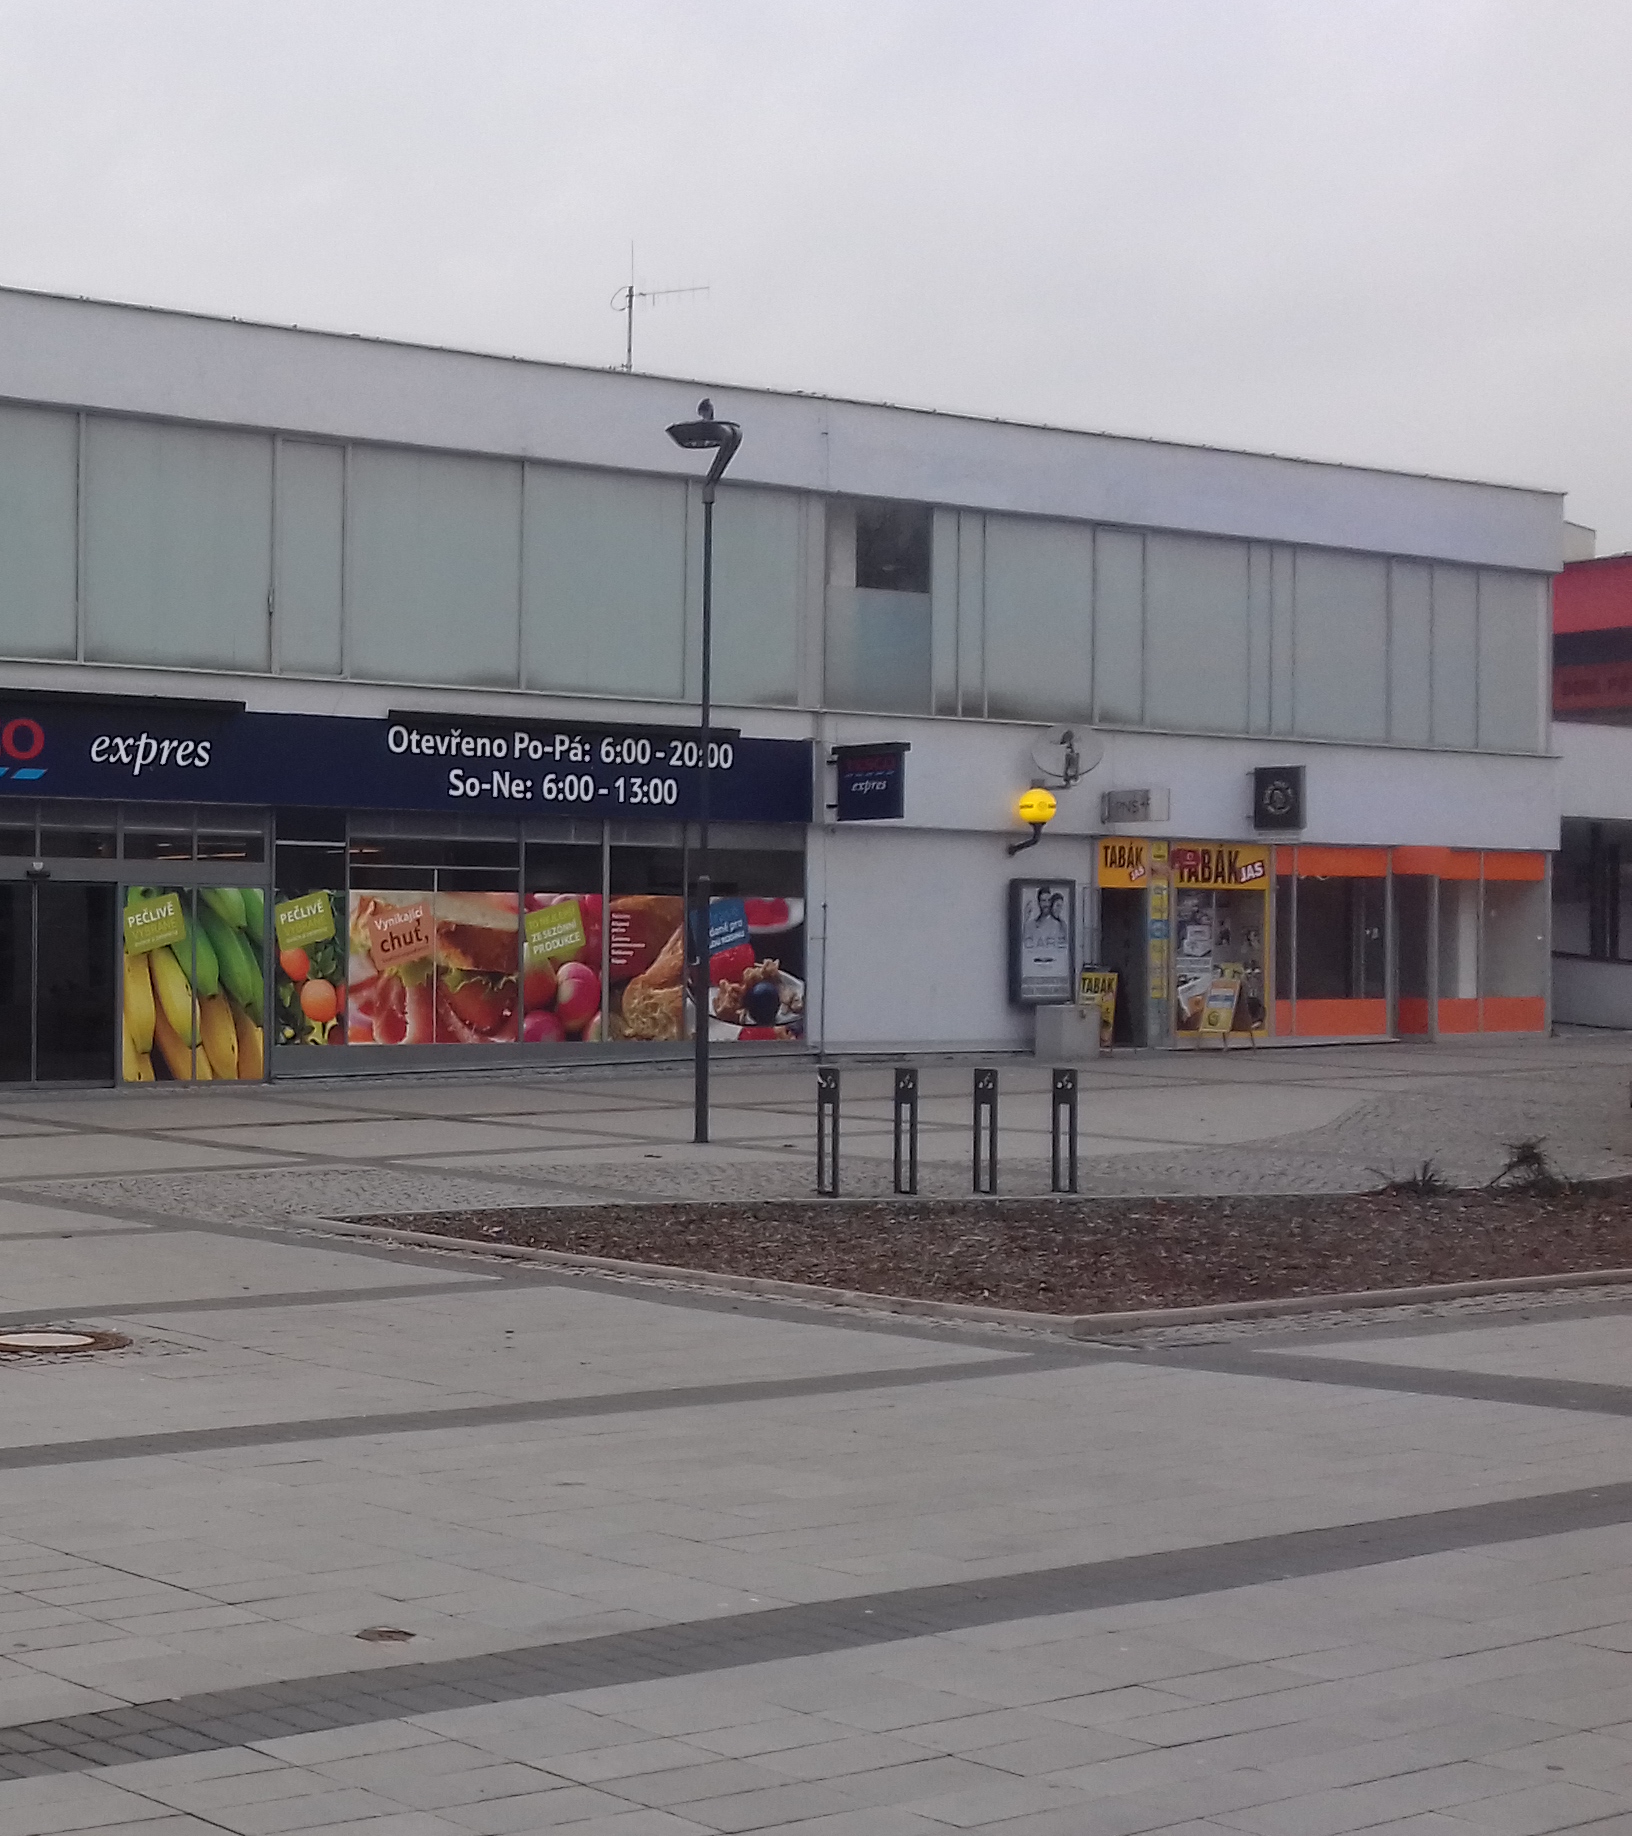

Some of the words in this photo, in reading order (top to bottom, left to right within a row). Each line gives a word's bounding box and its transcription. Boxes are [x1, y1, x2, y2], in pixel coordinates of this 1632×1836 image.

[89, 732, 212, 776] expres
[387, 725, 507, 758] Otevřeno
[514, 731, 591, 764] Po-Pá:
[600, 736, 651, 765] 6:00
[669, 740, 734, 769] 20:00
[448, 768, 533, 799] So-Ne:
[543, 773, 595, 802] 6:00
[614, 776, 678, 804] 13:00
[1103, 841, 1144, 869] TABÁK
[1240, 862, 1263, 883] JAS
[127, 901, 175, 928] PEČLIVĚ
[279, 898, 325, 925] PEČLIVĚ
